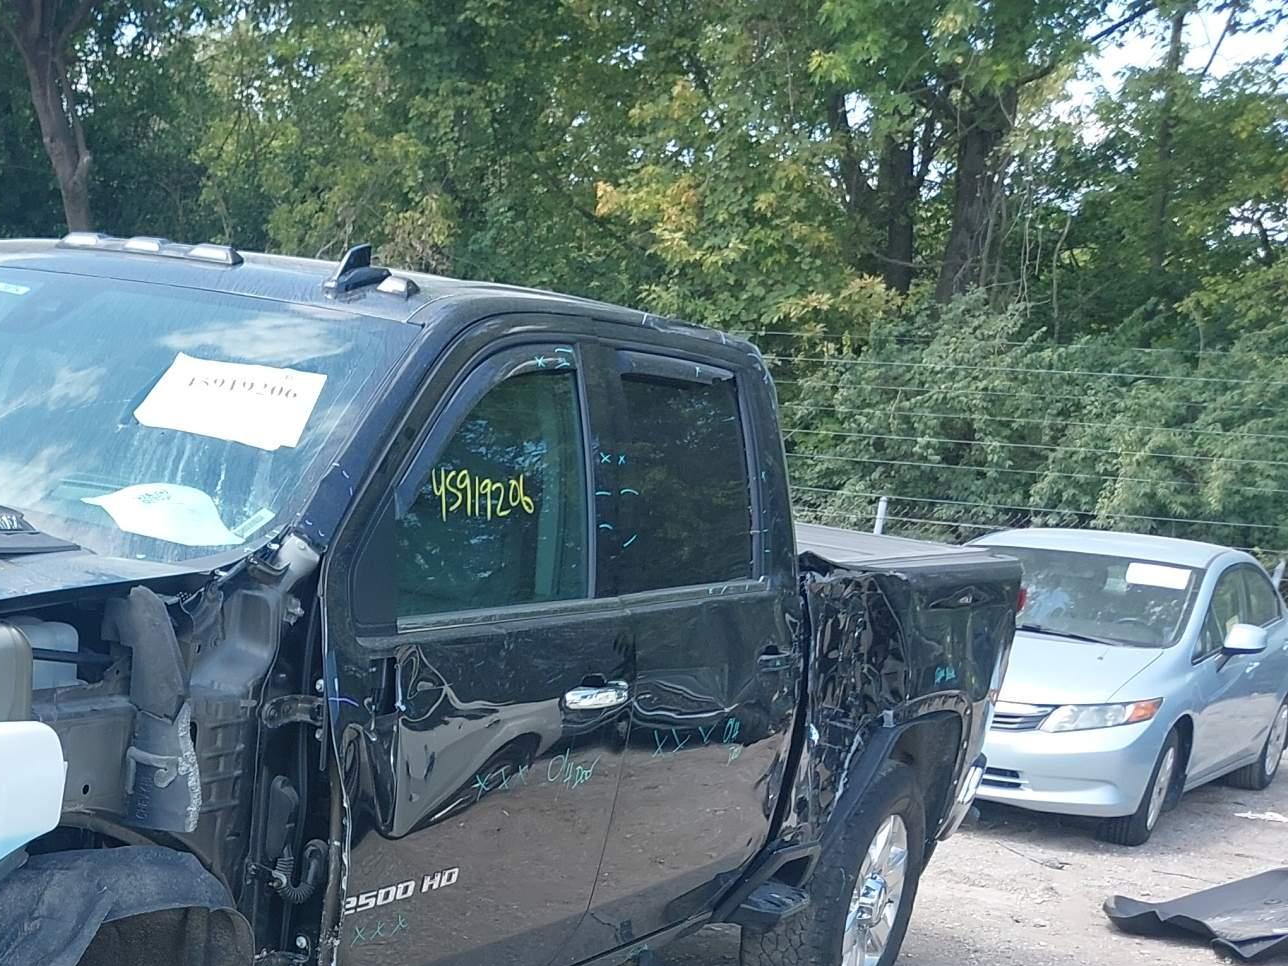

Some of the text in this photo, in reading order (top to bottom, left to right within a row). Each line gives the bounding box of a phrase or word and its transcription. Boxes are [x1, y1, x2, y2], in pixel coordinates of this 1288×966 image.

[432, 467, 534, 522] 45919206
[343, 867, 459, 915] 2500 HD
